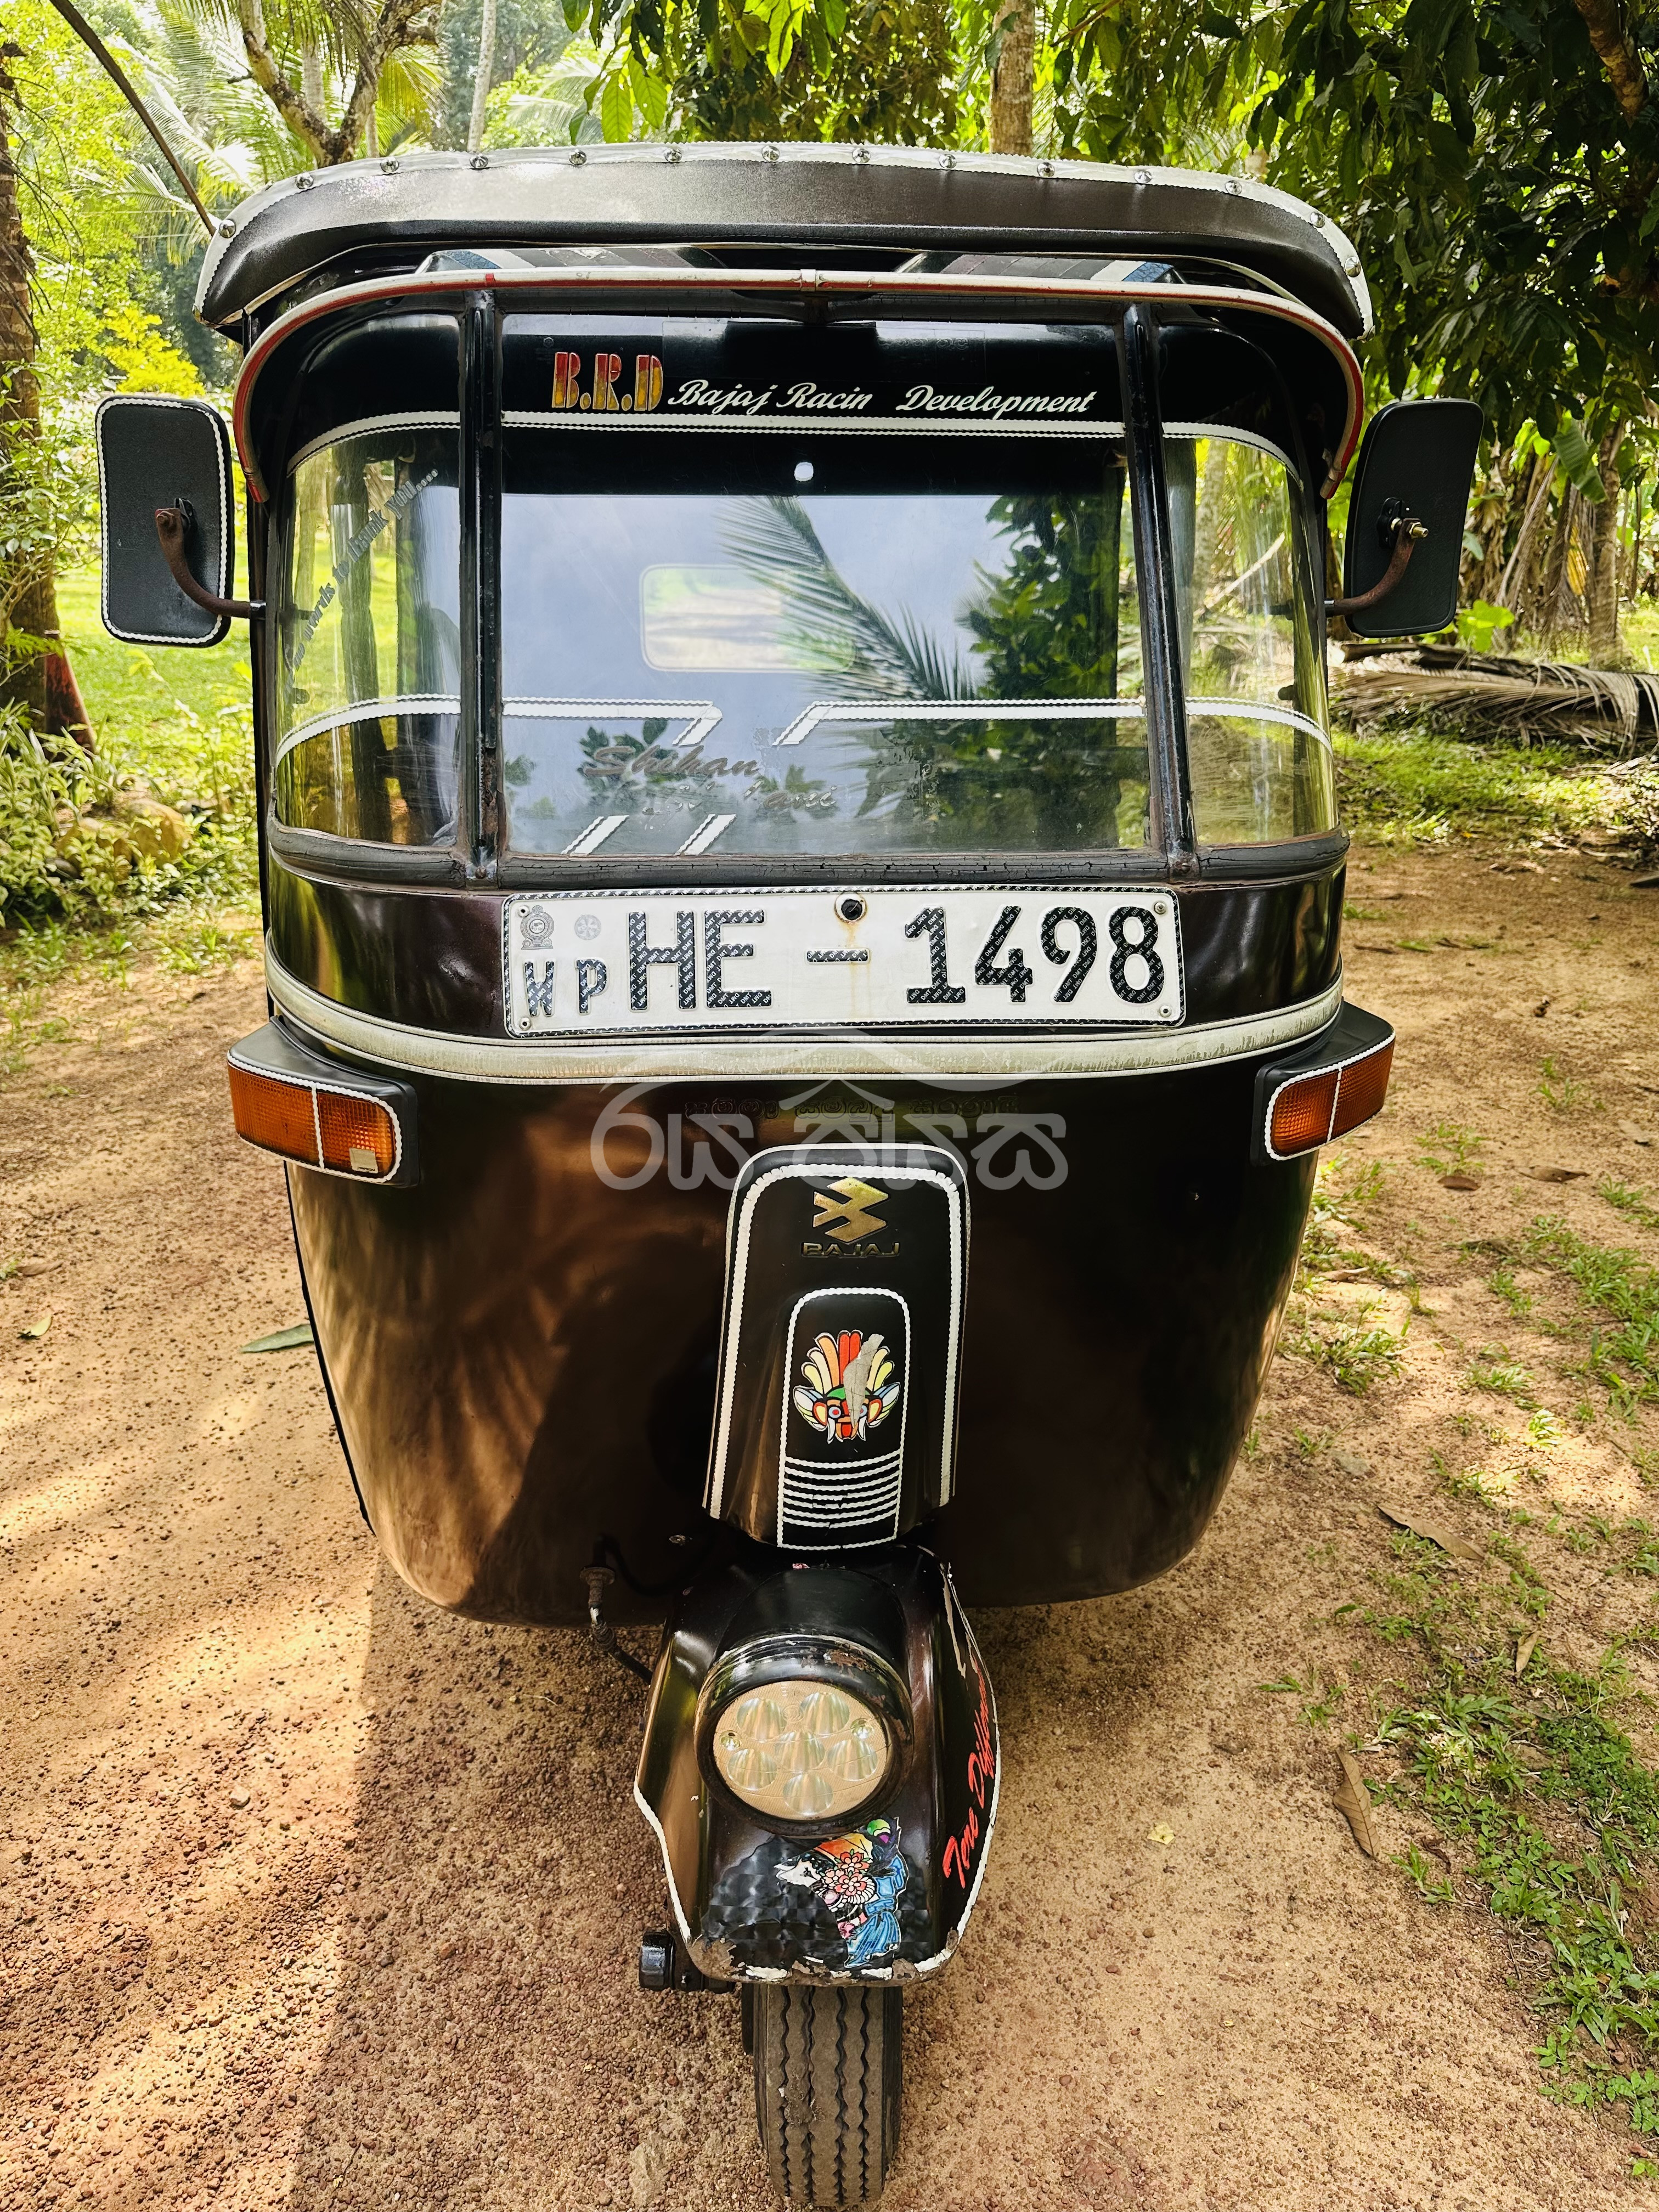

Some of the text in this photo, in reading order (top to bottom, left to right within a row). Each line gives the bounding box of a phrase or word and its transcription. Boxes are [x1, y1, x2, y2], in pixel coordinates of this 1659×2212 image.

[551, 352, 1097, 420] B.R.D Bajaj Racin Development
[332, 560, 350, 584] to
[347, 509, 389, 563] thank
[629, 909, 772, 1011] HE
[904, 905, 1165, 1005] 1498
[801, 1242, 901, 1259] BAJAJ
